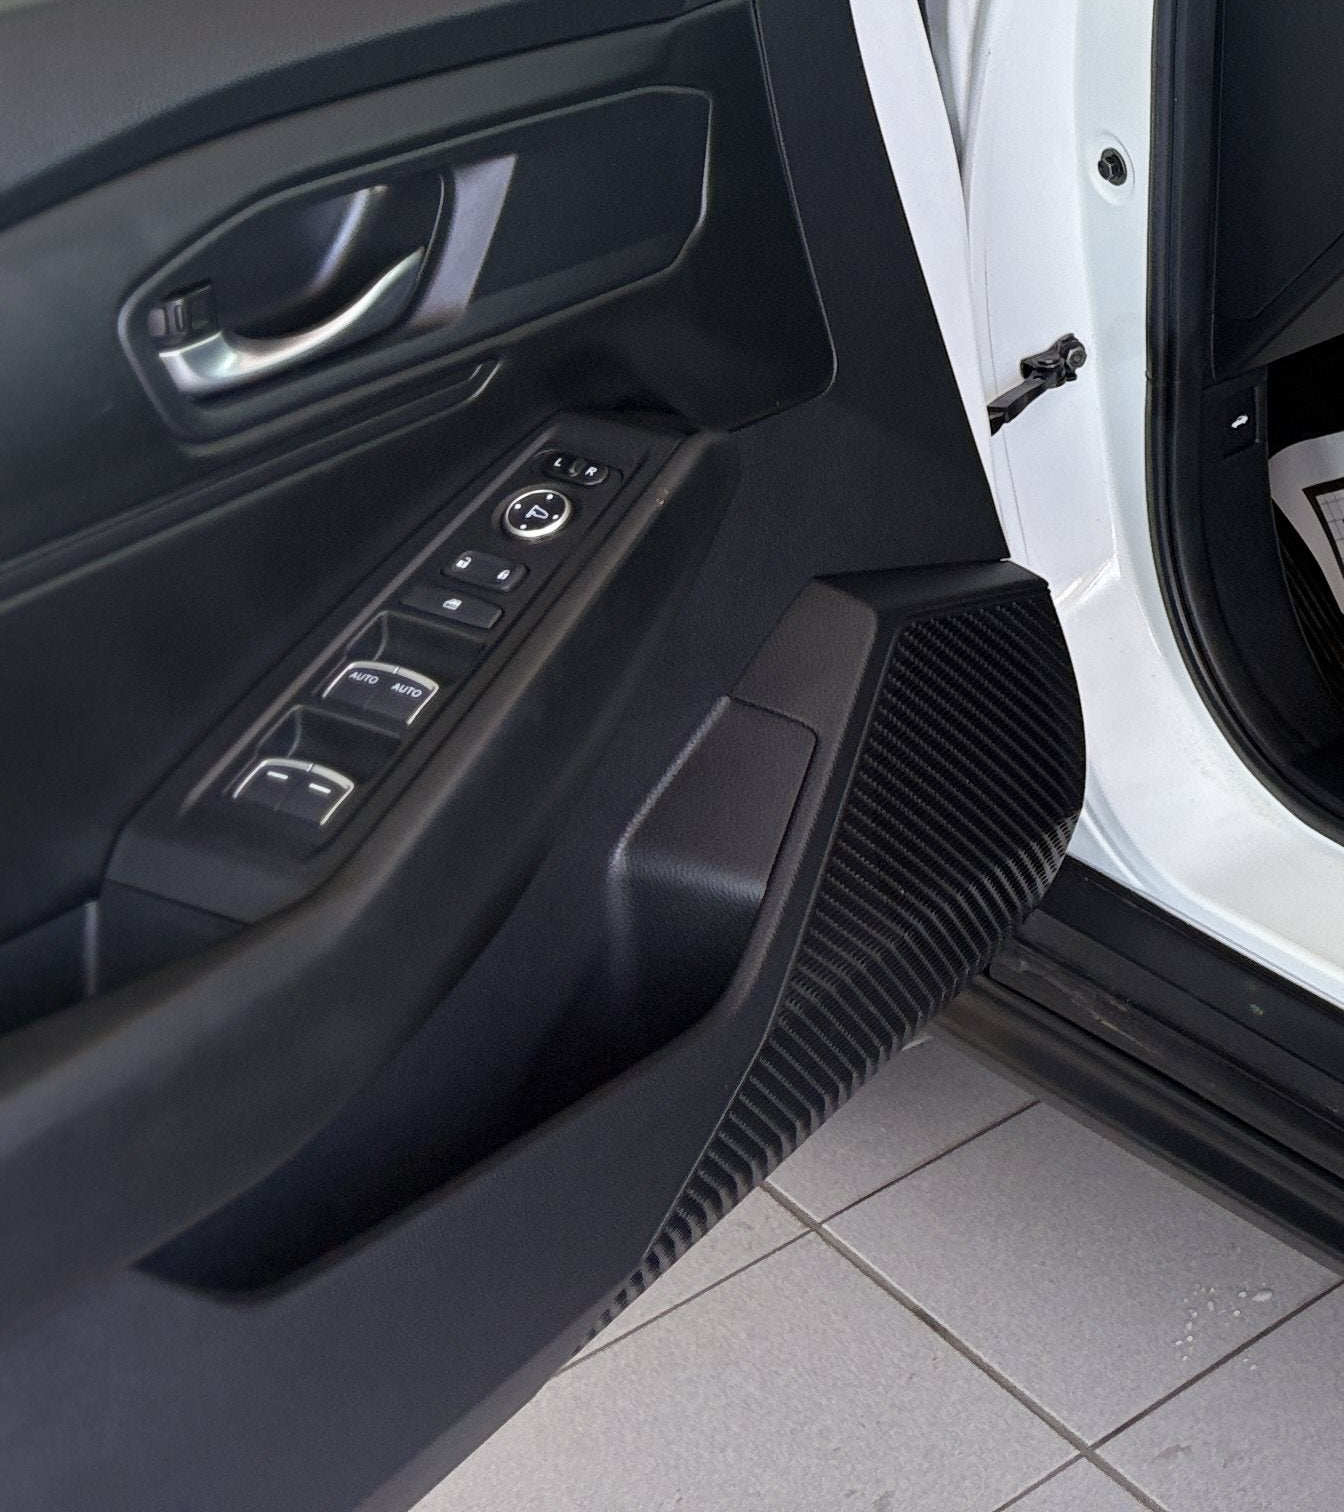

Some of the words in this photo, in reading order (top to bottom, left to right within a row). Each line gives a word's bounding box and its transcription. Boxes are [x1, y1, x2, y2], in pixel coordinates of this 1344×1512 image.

[553, 457, 563, 467] L
[585, 466, 598, 476] R
[348, 671, 379, 684] AUTO
[391, 682, 422, 697] AUTO
